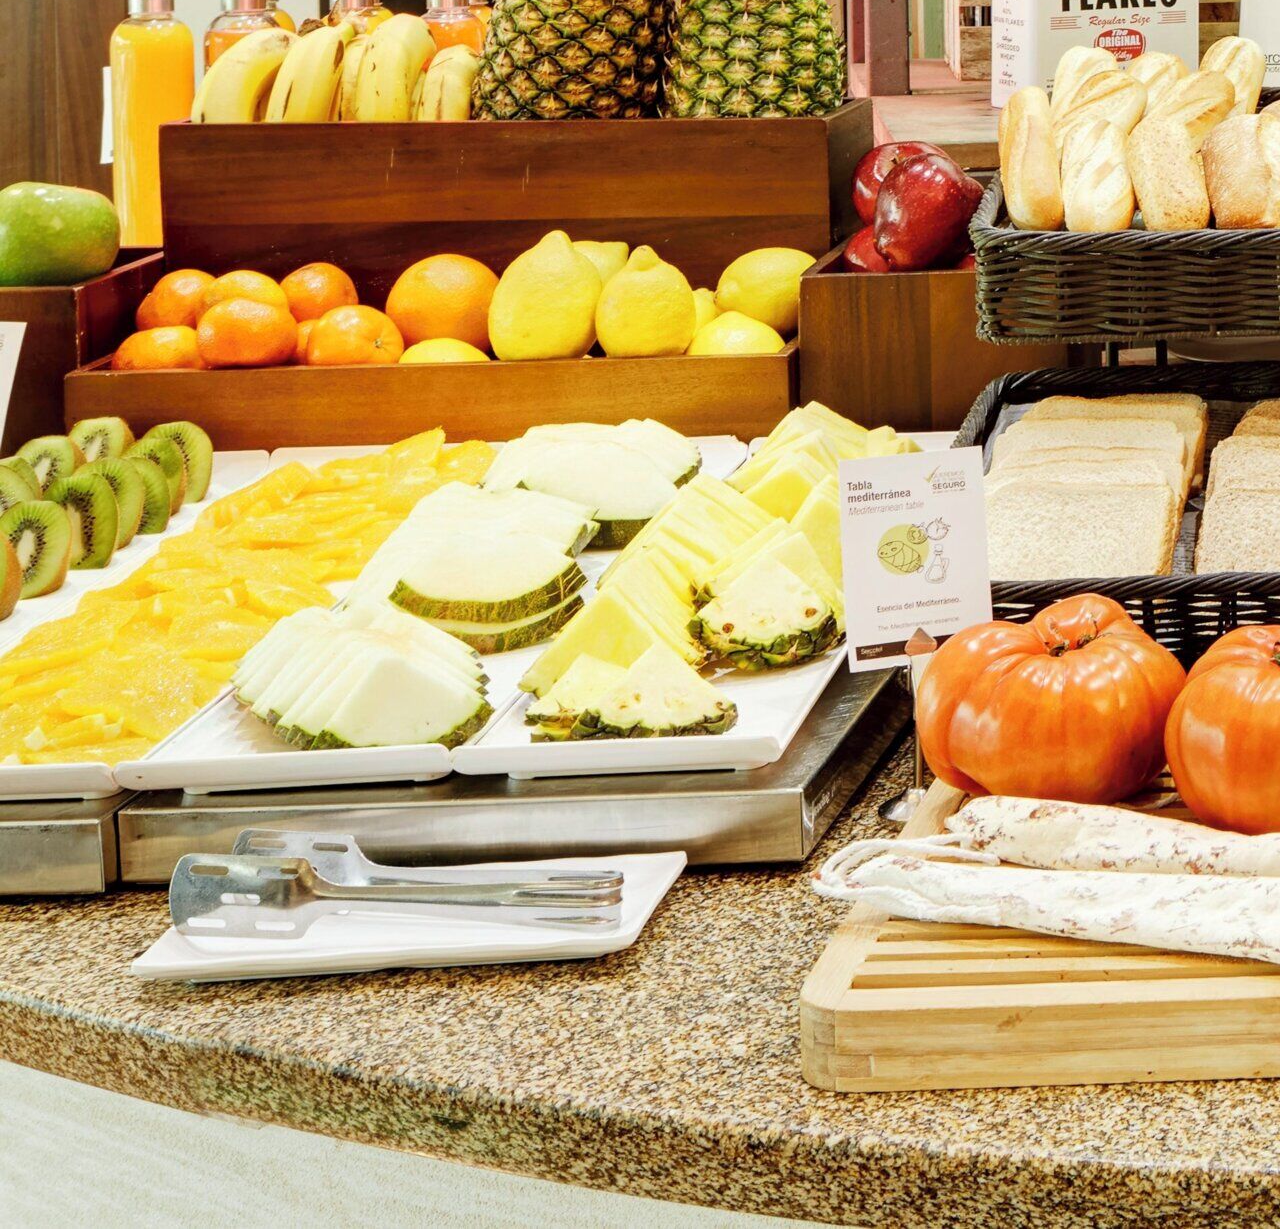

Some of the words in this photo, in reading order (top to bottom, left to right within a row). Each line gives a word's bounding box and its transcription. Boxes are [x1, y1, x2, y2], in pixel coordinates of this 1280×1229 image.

[1088, 15, 1126, 28] Regular
[1130, 13, 1151, 26] Size
[1099, 34, 1141, 48] ORIGINAL
[847, 481, 872, 491] Tabla
[932, 481, 966, 491] SEGURO
[848, 489, 911, 503] mediterránea
